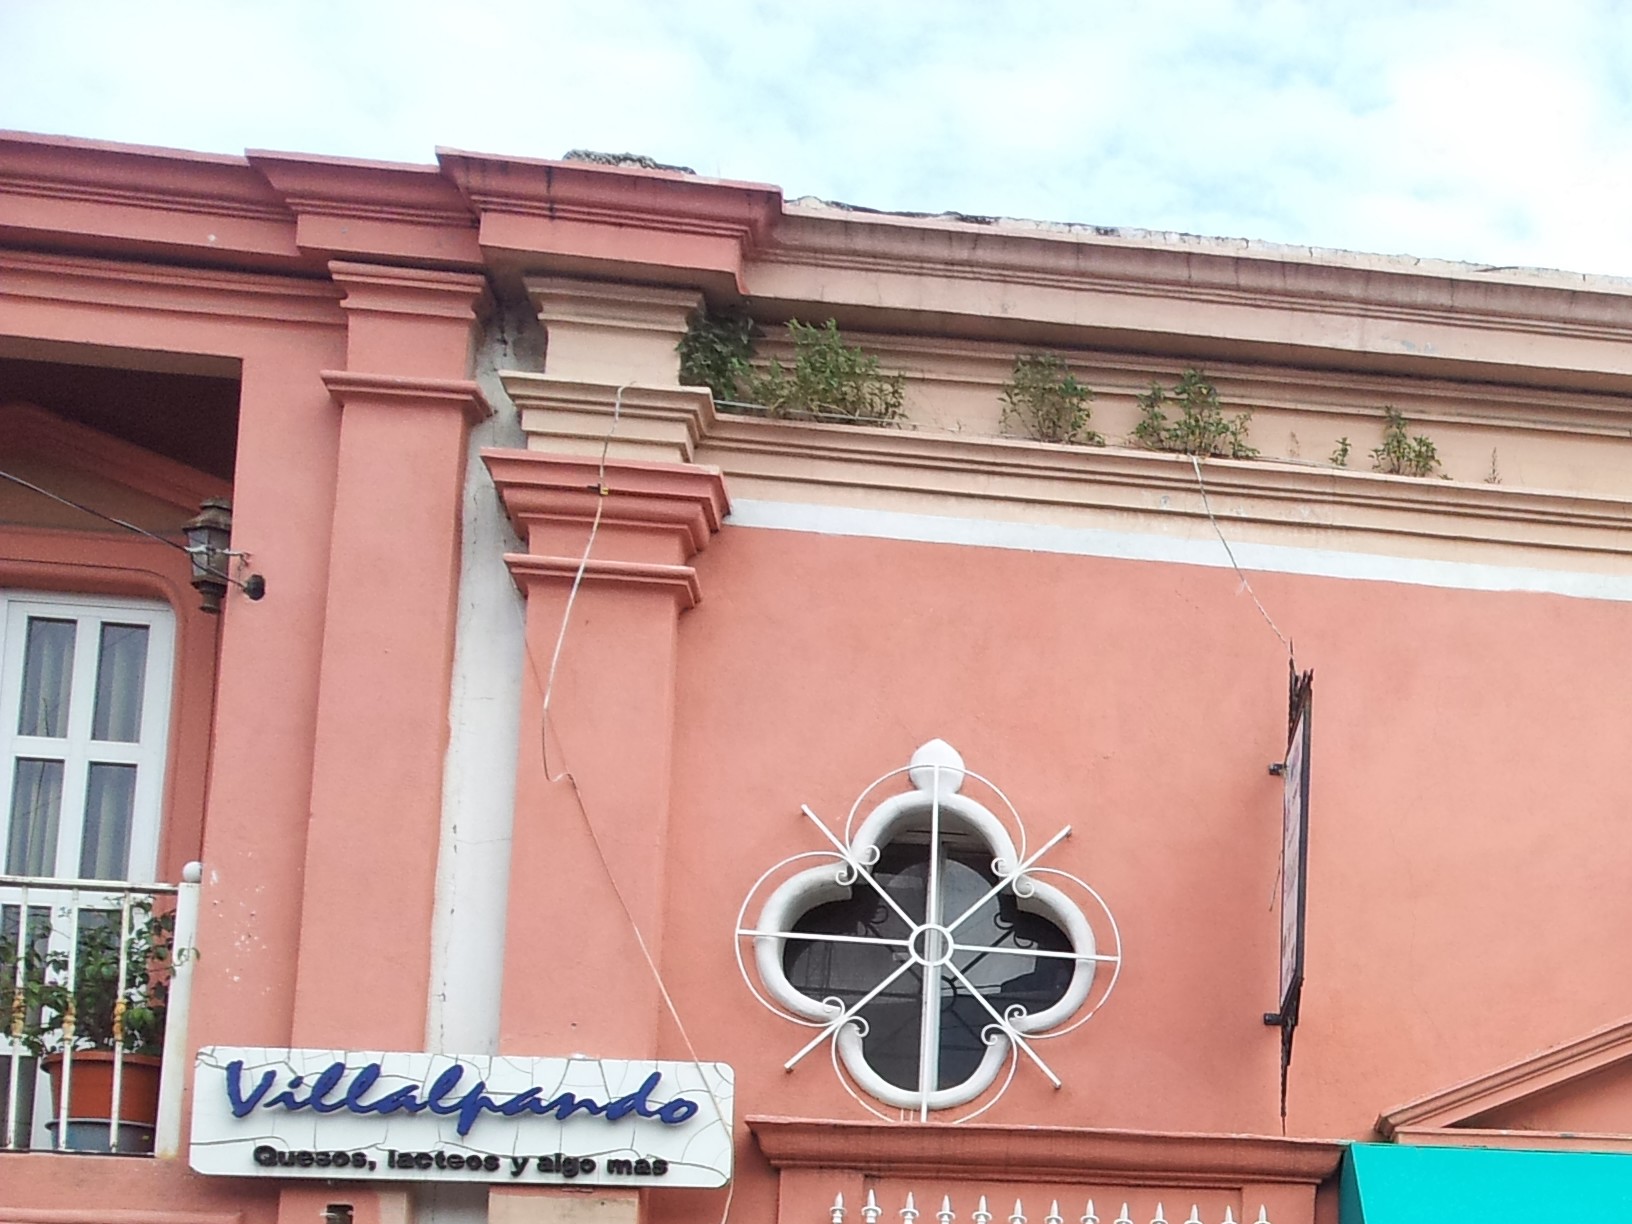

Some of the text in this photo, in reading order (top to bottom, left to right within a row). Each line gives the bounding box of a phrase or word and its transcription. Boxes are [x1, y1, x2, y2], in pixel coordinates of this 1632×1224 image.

[226, 1059, 699, 1136] Villalpando
[253, 1145, 669, 1178] Quesos, lacteos y algo mas
